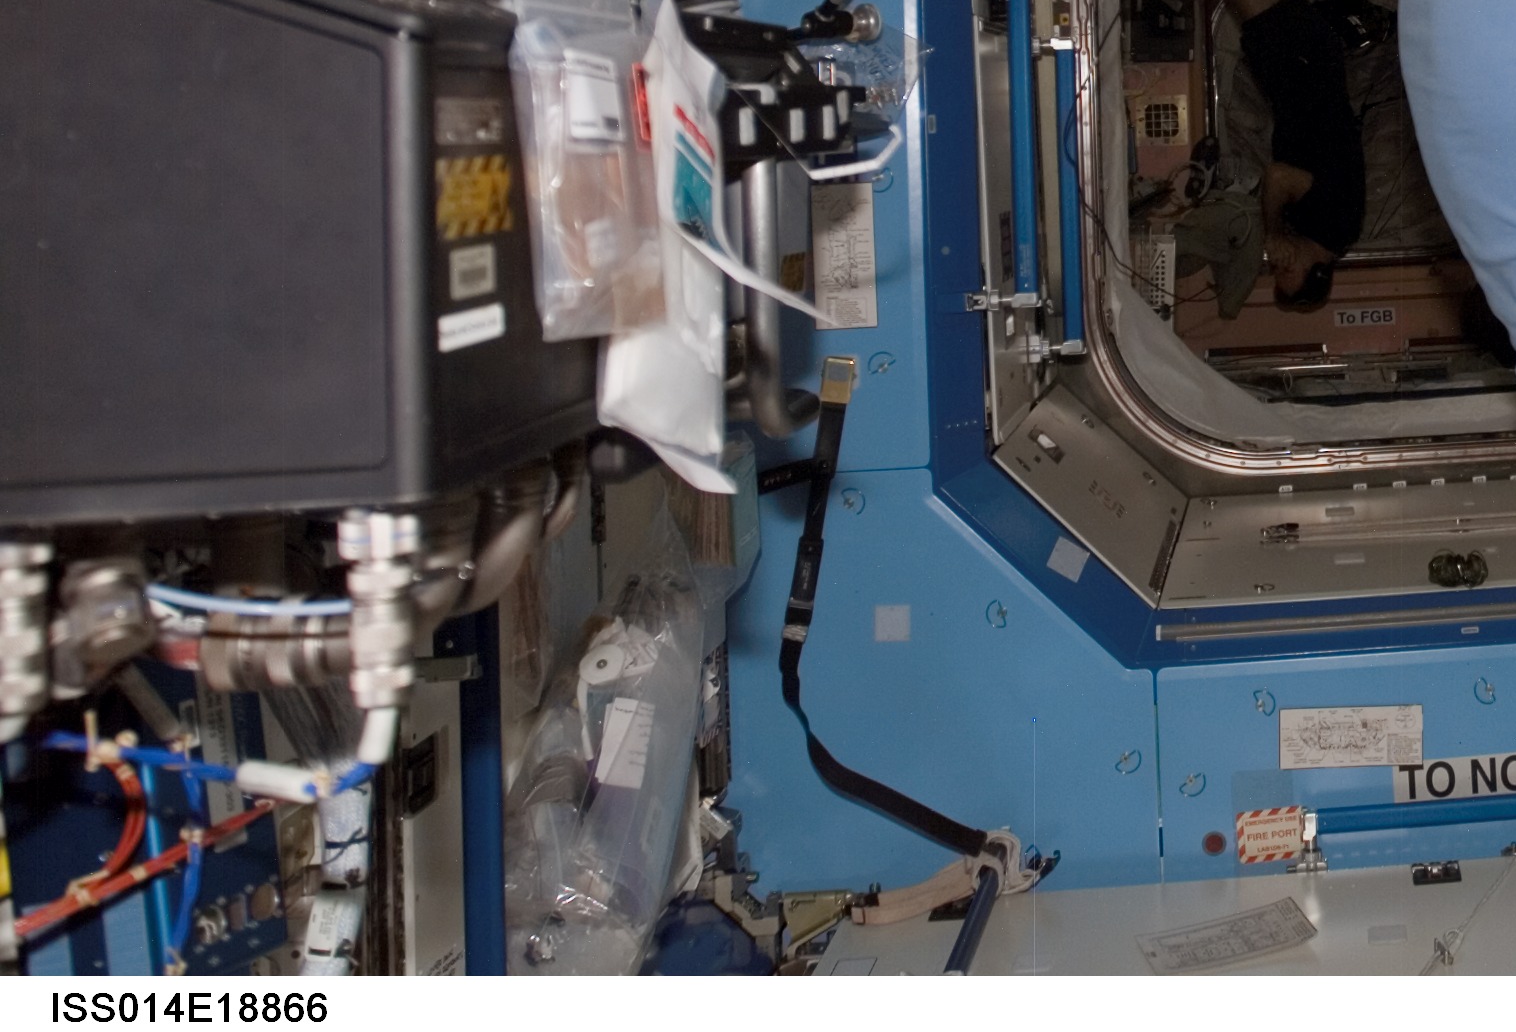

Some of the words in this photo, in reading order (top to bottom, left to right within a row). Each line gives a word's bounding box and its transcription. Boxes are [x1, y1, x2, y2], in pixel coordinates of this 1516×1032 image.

[1337, 311, 1355, 324] To
[1361, 310, 1393, 323] FGB
[1398, 761, 1456, 800] TO
[1246, 831, 1269, 842] FIRE
[1271, 828, 1298, 839] PORT
